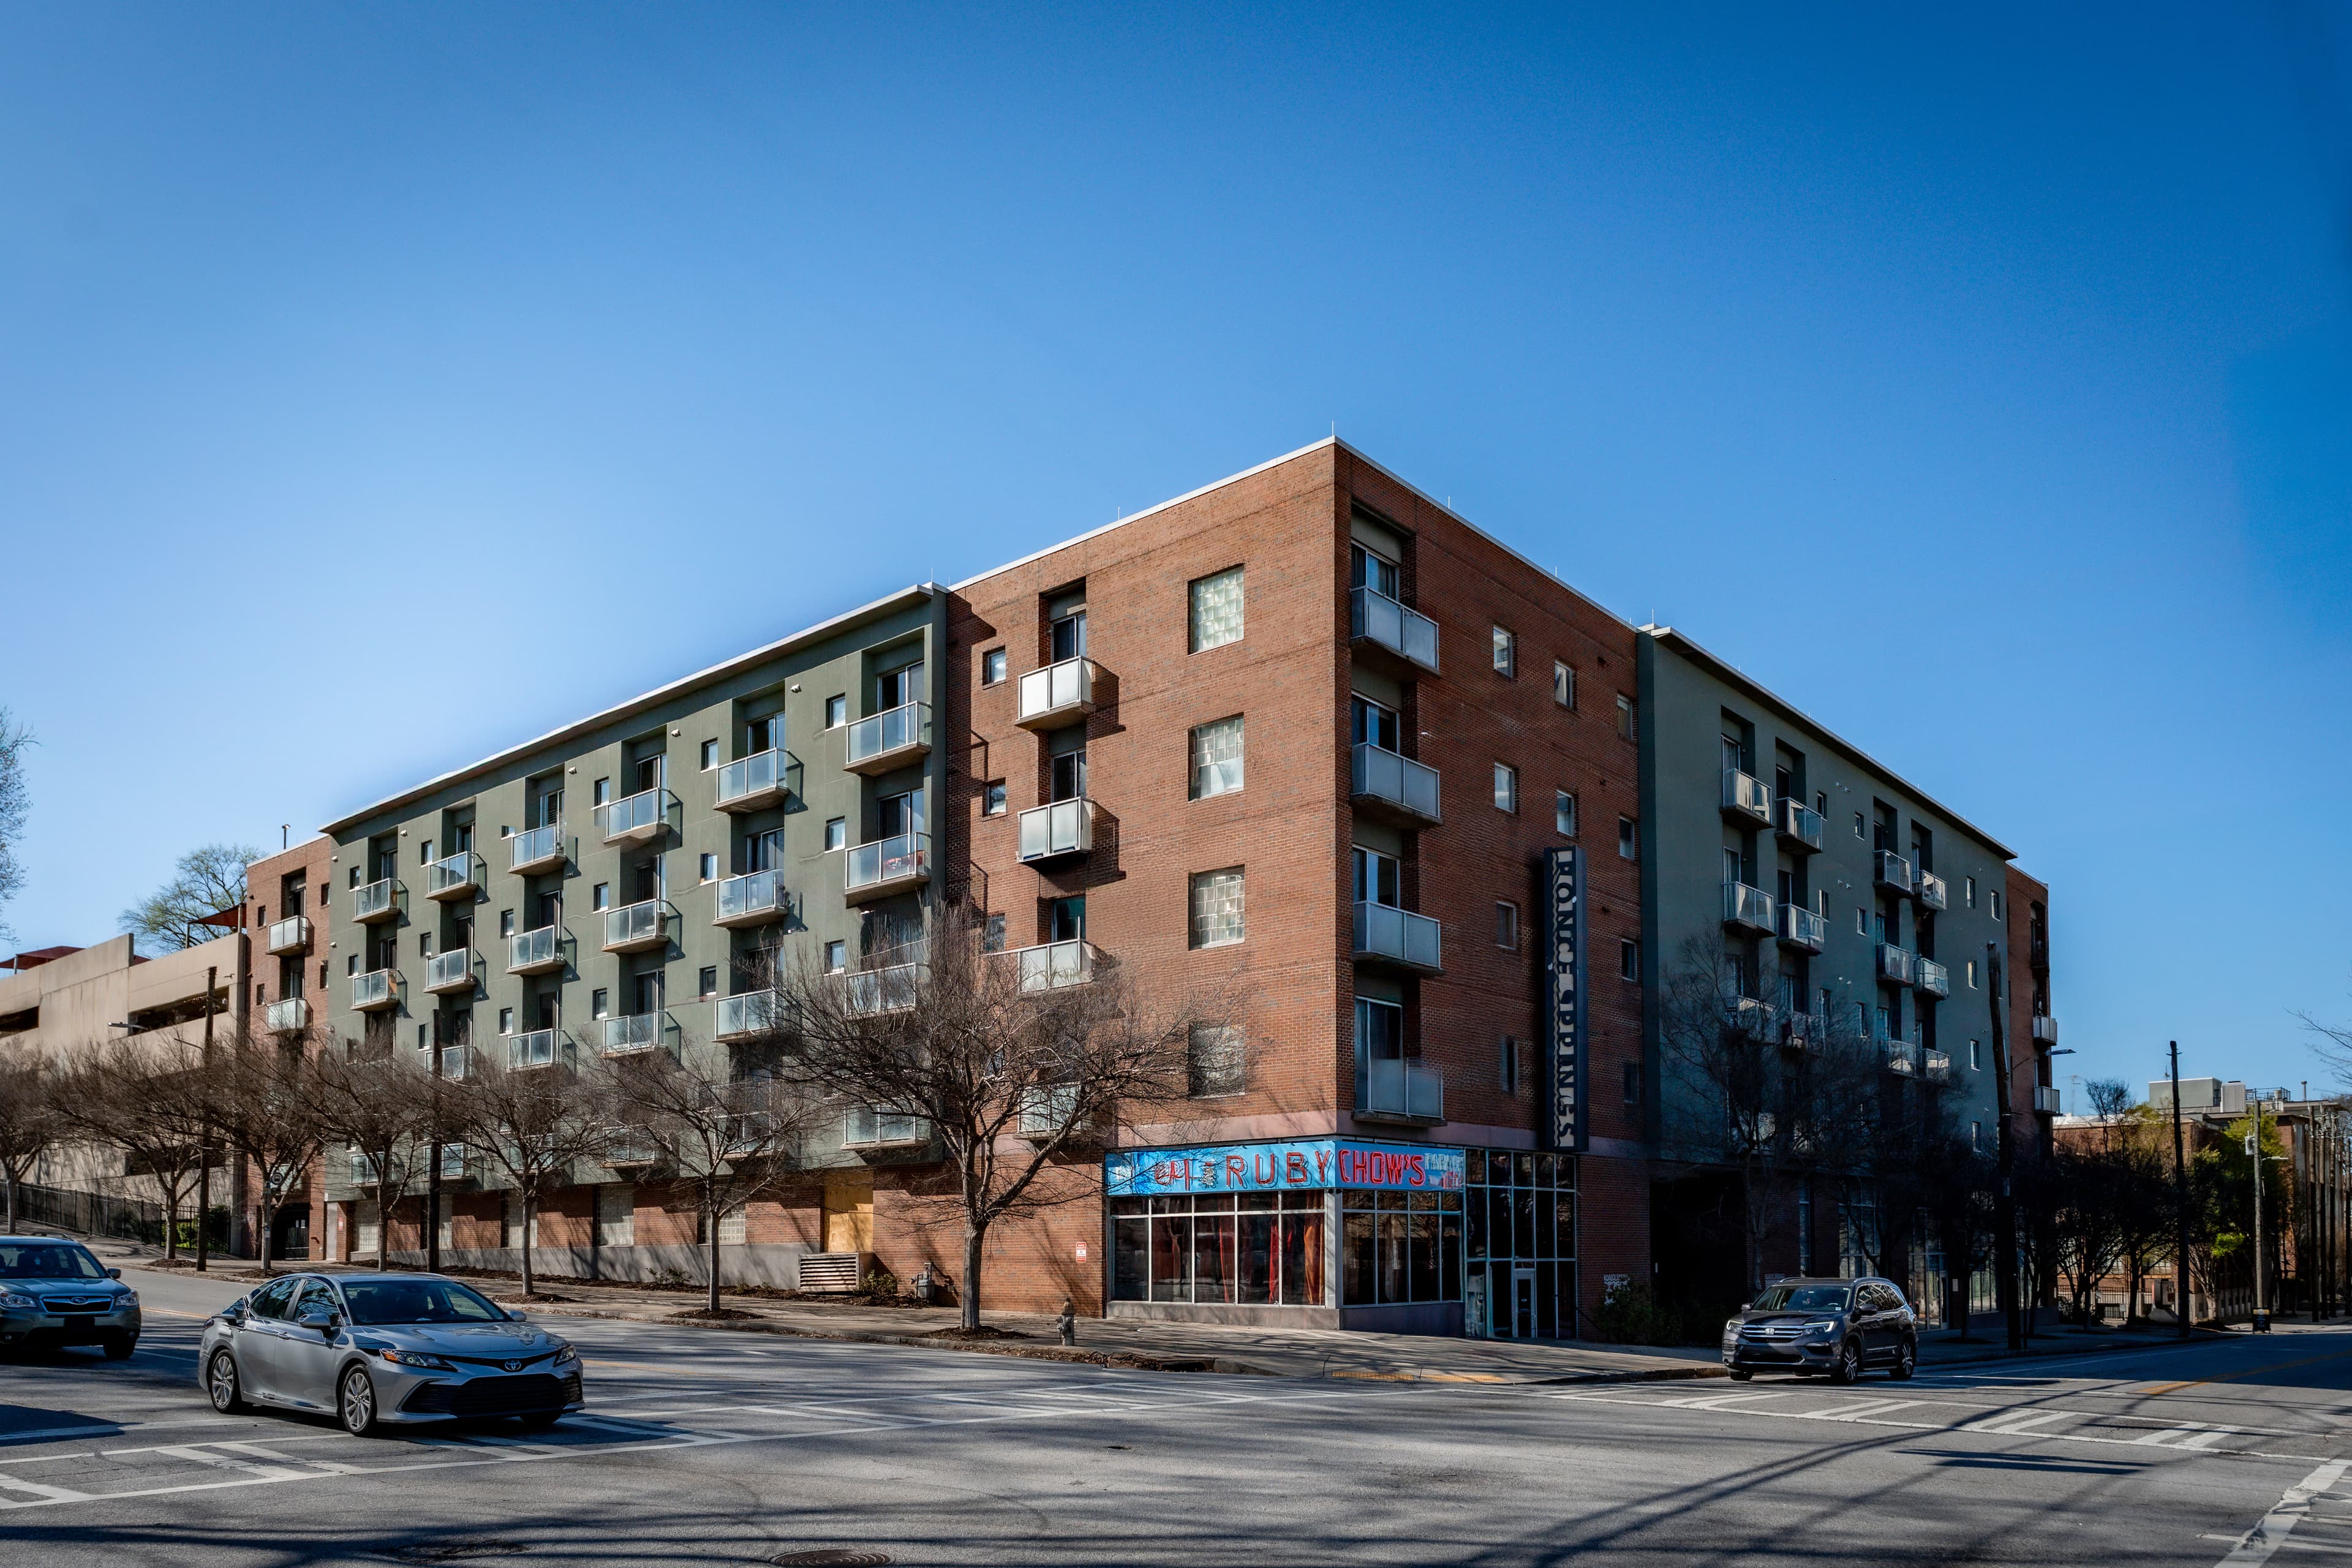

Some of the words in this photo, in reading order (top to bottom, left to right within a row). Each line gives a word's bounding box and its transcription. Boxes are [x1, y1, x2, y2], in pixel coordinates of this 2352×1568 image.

[1556, 861, 1574, 974] PONCE
[1226, 1150, 1333, 1188] RUBY
[1339, 1149, 1426, 1186] CHOW'S
